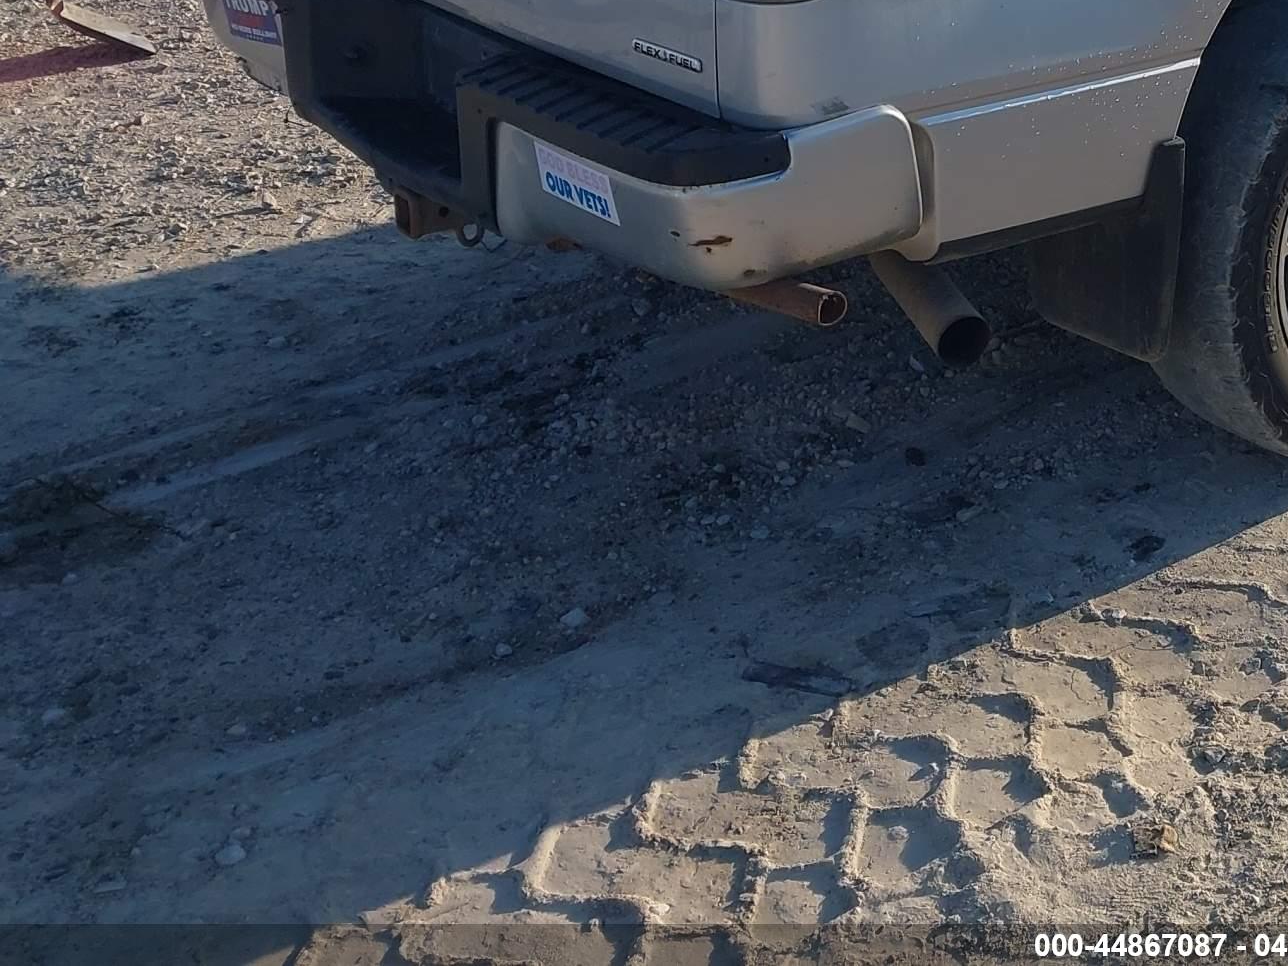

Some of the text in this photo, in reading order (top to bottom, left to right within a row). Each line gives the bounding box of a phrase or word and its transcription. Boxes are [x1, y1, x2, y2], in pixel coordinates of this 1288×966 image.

[634, 40, 700, 72] FLEX FUEL
[546, 171, 612, 219] OUR VETS!
